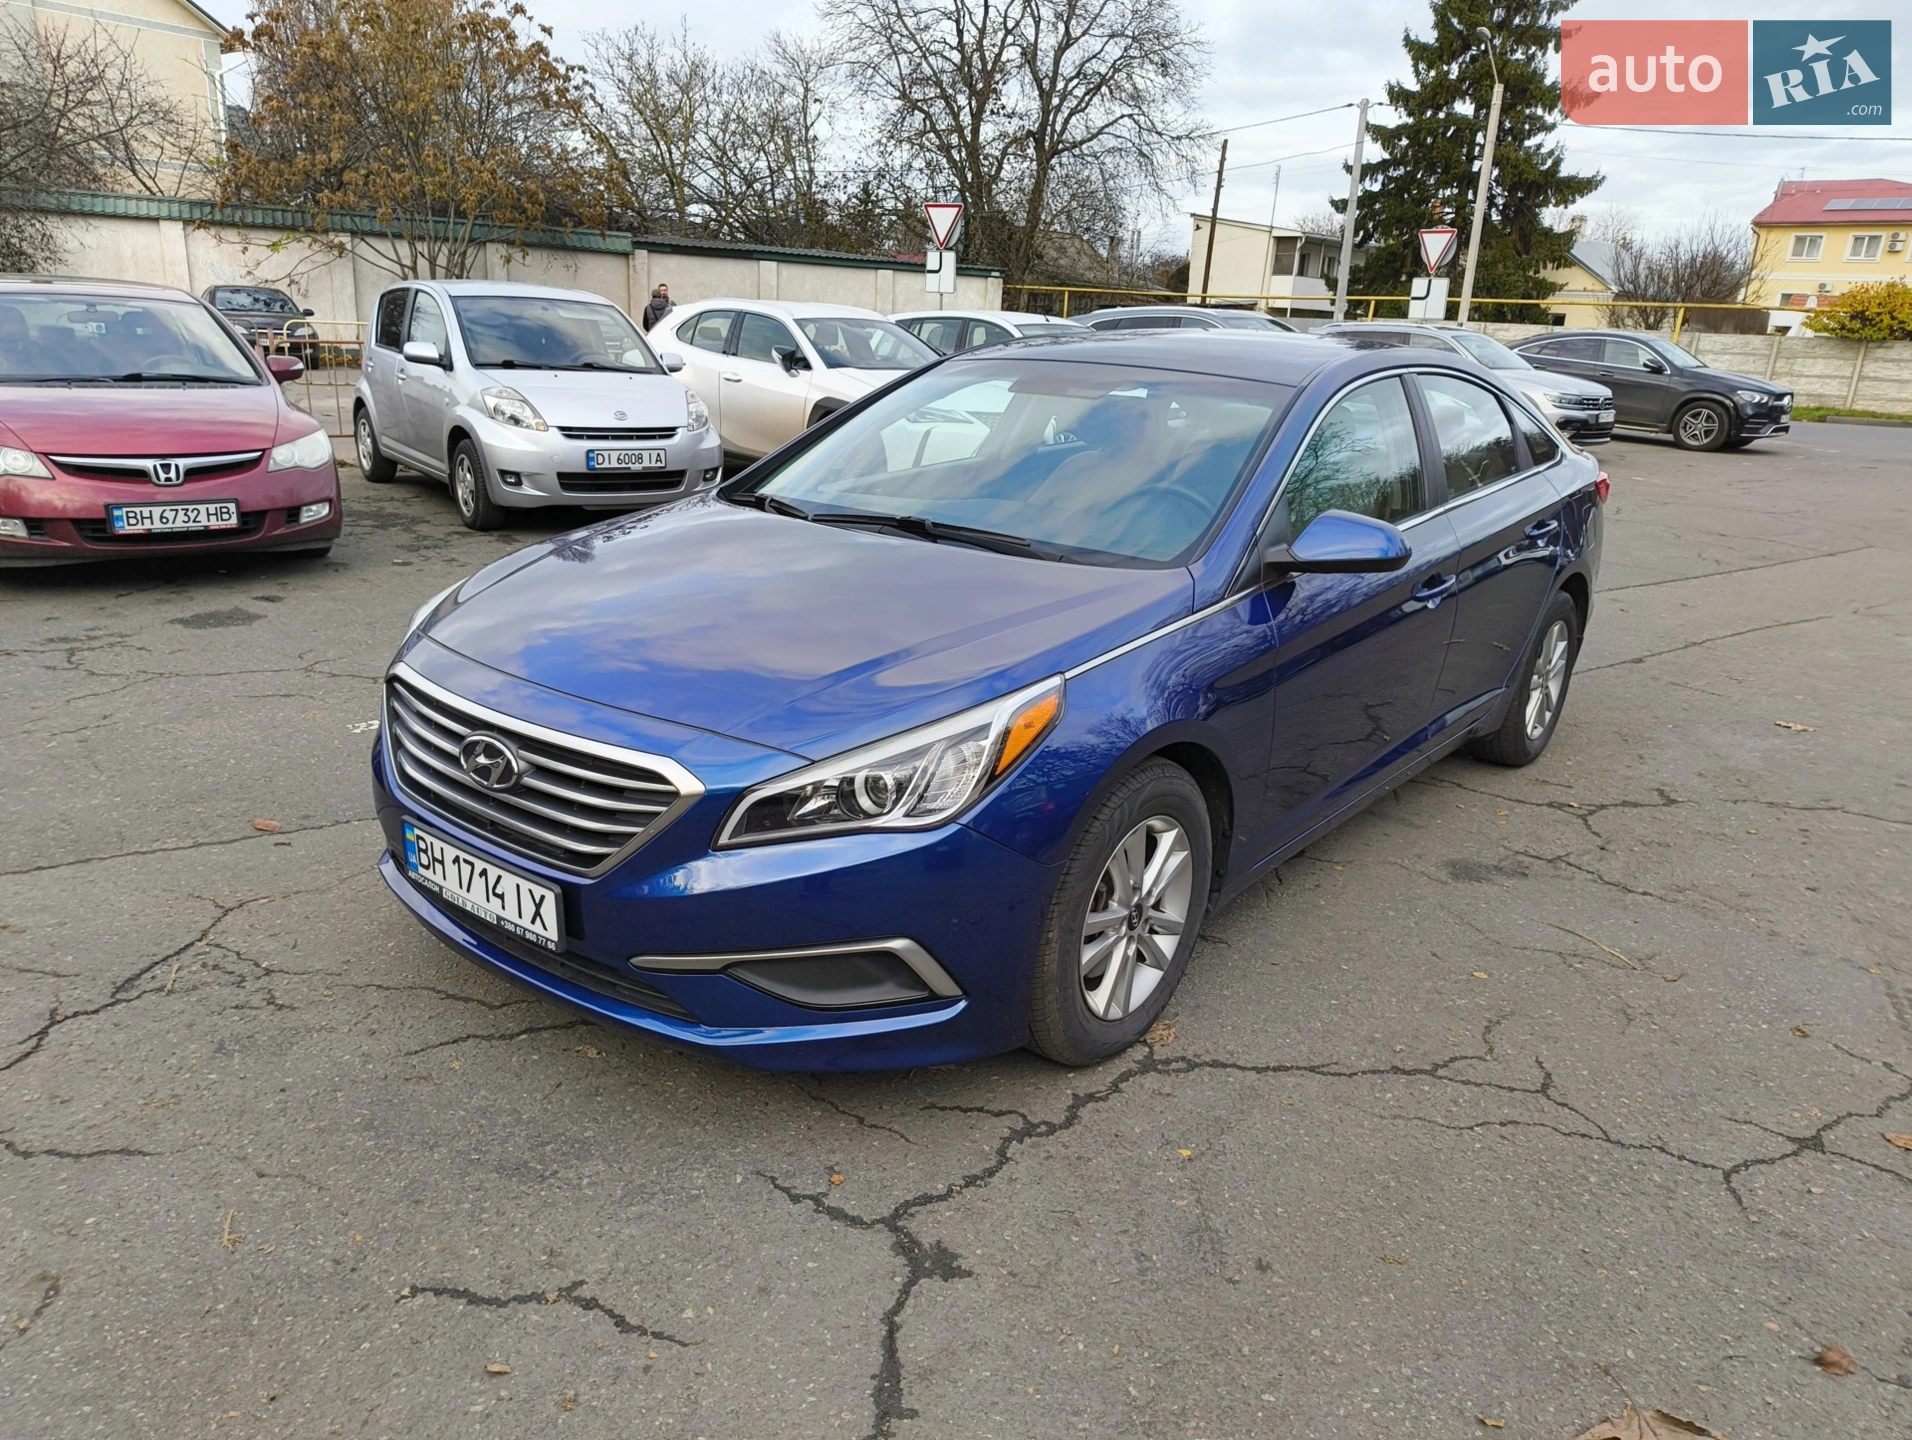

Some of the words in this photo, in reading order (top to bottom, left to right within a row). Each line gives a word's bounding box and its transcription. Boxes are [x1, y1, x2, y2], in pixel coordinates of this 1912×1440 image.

[596, 453, 612, 465] DI
[616, 452, 644, 465] 6008
[648, 452, 663, 465] IA
[125, 510, 154, 527] BH
[159, 507, 201, 525] 6732
[206, 505, 232, 523] HB
[407, 851, 418, 864] UA
[408, 869, 440, 894] АВТОСАЛОН
[416, 833, 447, 882] BH
[452, 854, 506, 911] 1714
[516, 882, 548, 931] IX
[444, 889, 468, 908] GOLD
[470, 903, 496, 923] AUTO
